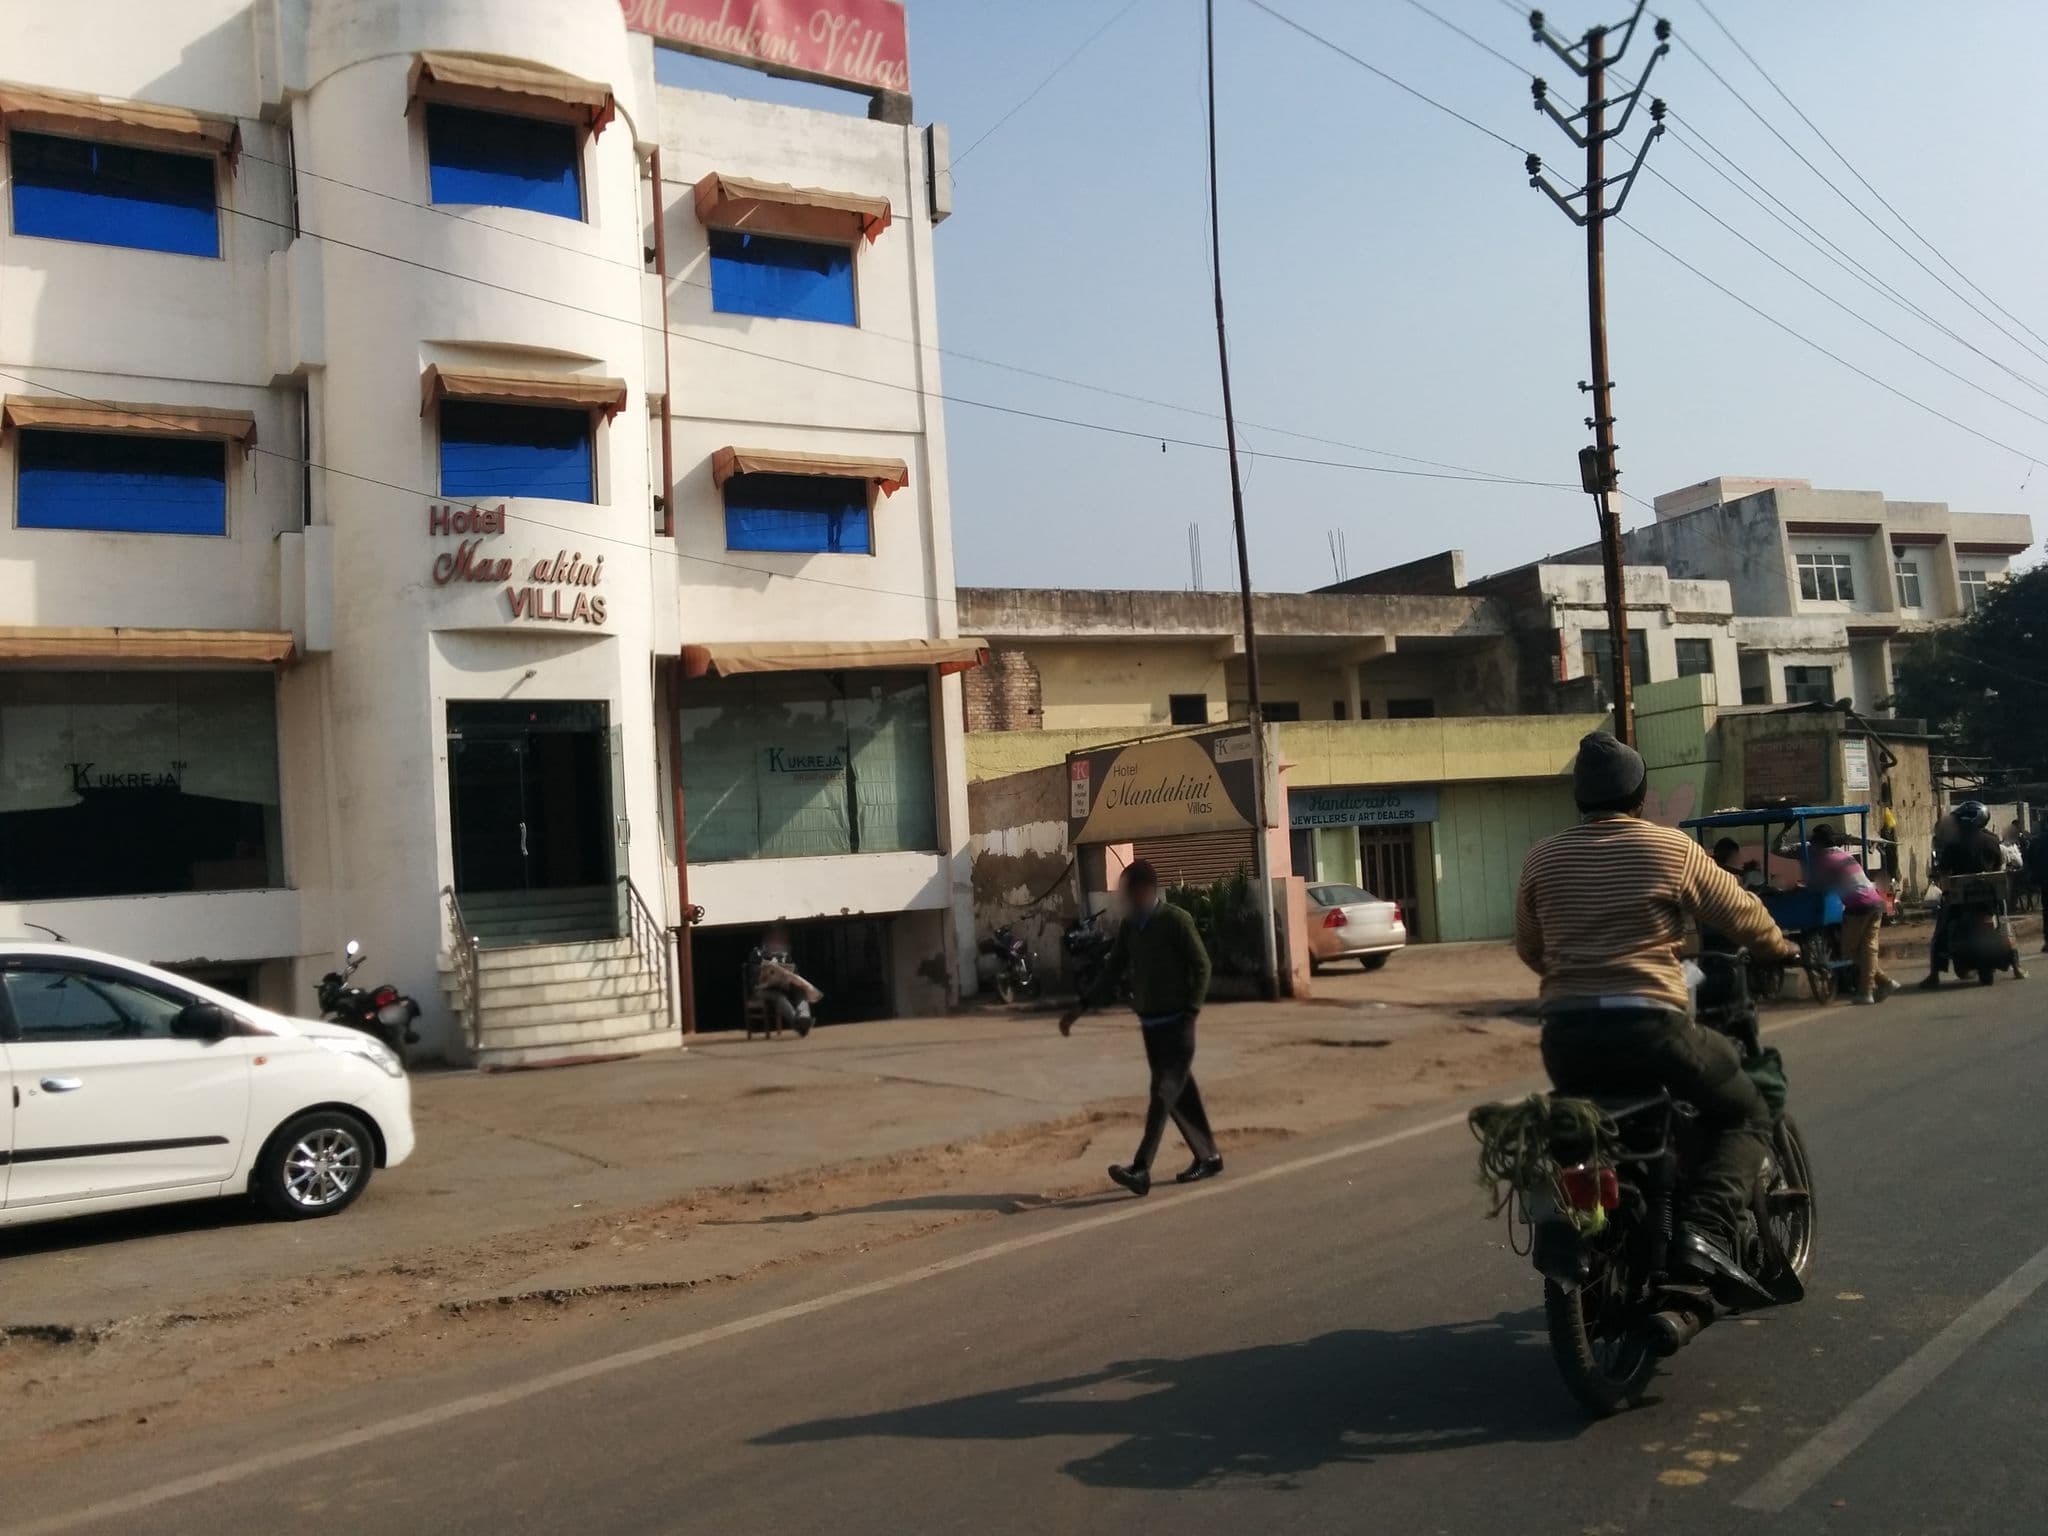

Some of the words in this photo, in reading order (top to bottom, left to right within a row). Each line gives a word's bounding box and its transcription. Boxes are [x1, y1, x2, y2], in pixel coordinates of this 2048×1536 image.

[808, 9, 906, 84] Villas
[429, 503, 505, 537] Hotel
[505, 586, 608, 626] VILLAS
[765, 747, 842, 771] KUKREJA
[1113, 763, 1139, 778] Hotel
[65, 762, 176, 792] KUKREJA
[1106, 774, 1213, 810] Mandakini
[1187, 801, 1213, 816] Villas
[1291, 813, 1348, 826] JEWELLERS
[1358, 811, 1374, 822] ART
[1377, 809, 1416, 821] DEALERS
